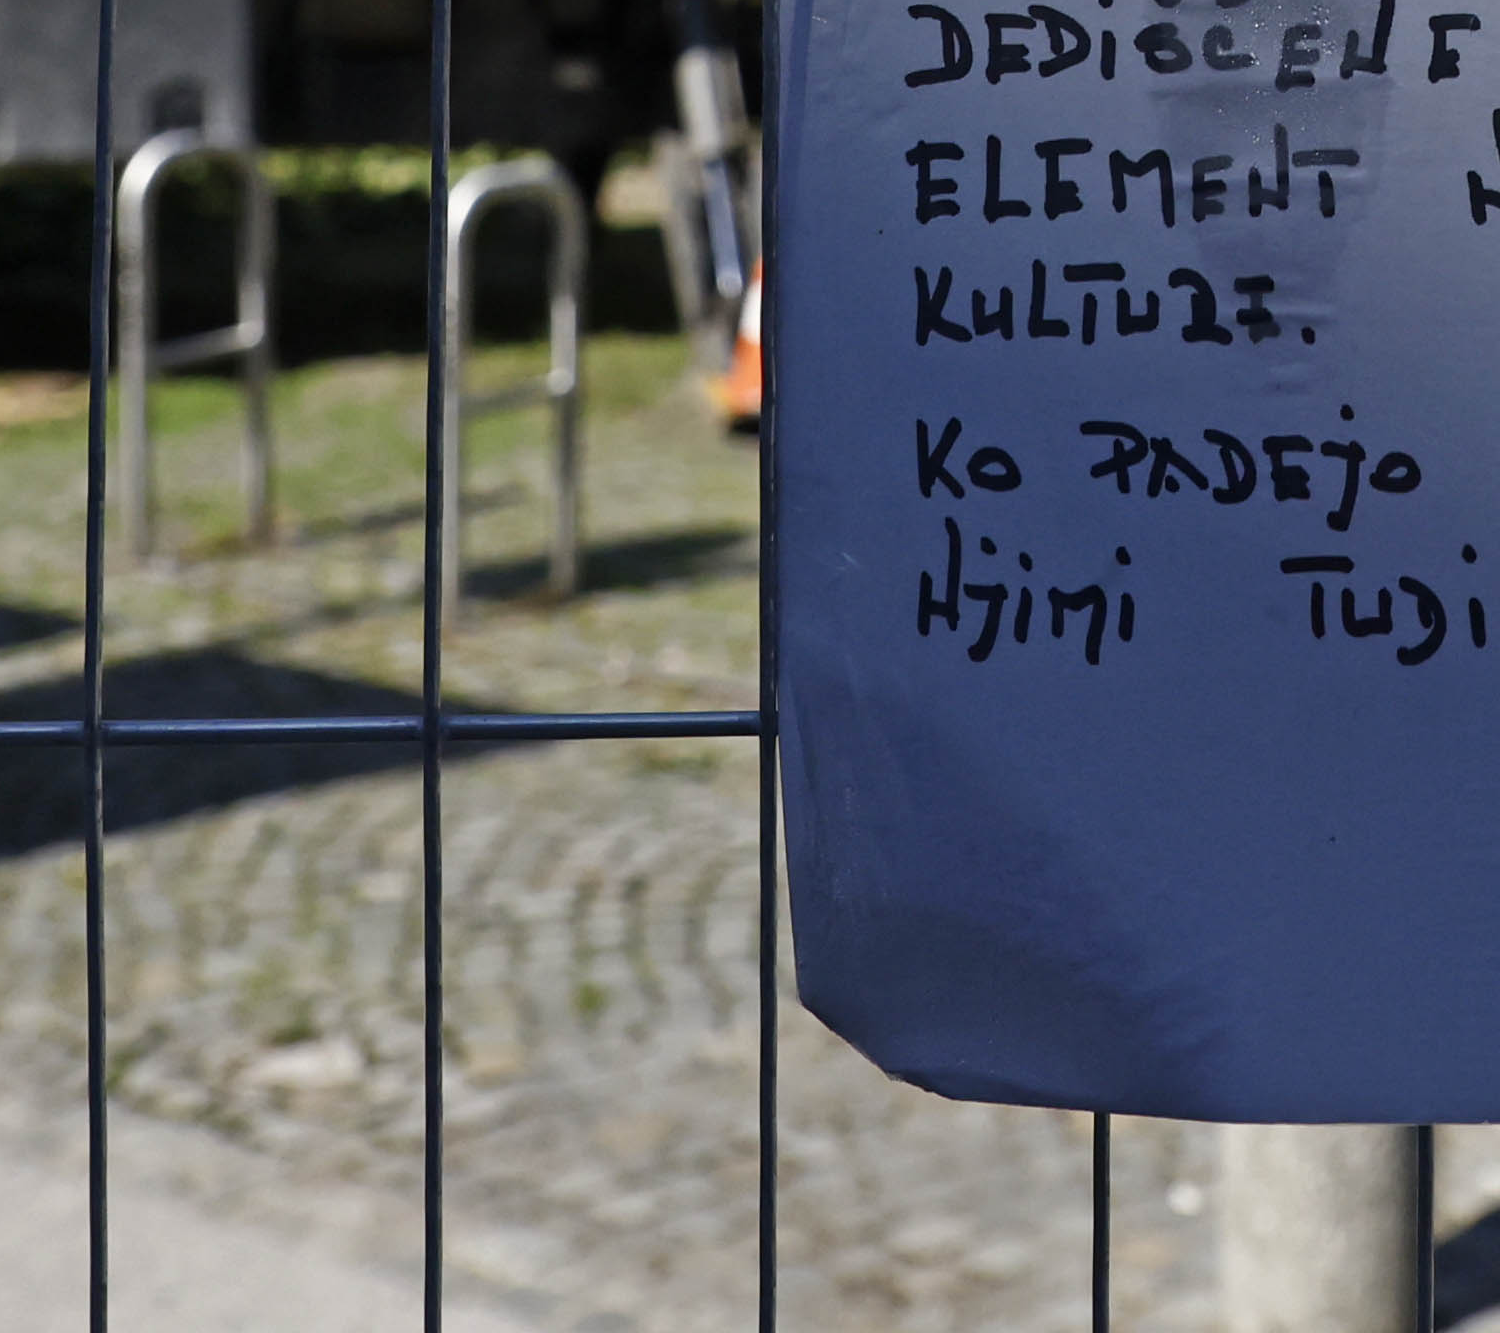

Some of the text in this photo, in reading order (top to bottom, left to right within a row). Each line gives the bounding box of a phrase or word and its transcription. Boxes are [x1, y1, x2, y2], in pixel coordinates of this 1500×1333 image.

[905, 125, 1359, 227] ELEMENT
[915, 260, 1315, 346] KULTURE.
[915, 416, 1022, 499] KO
